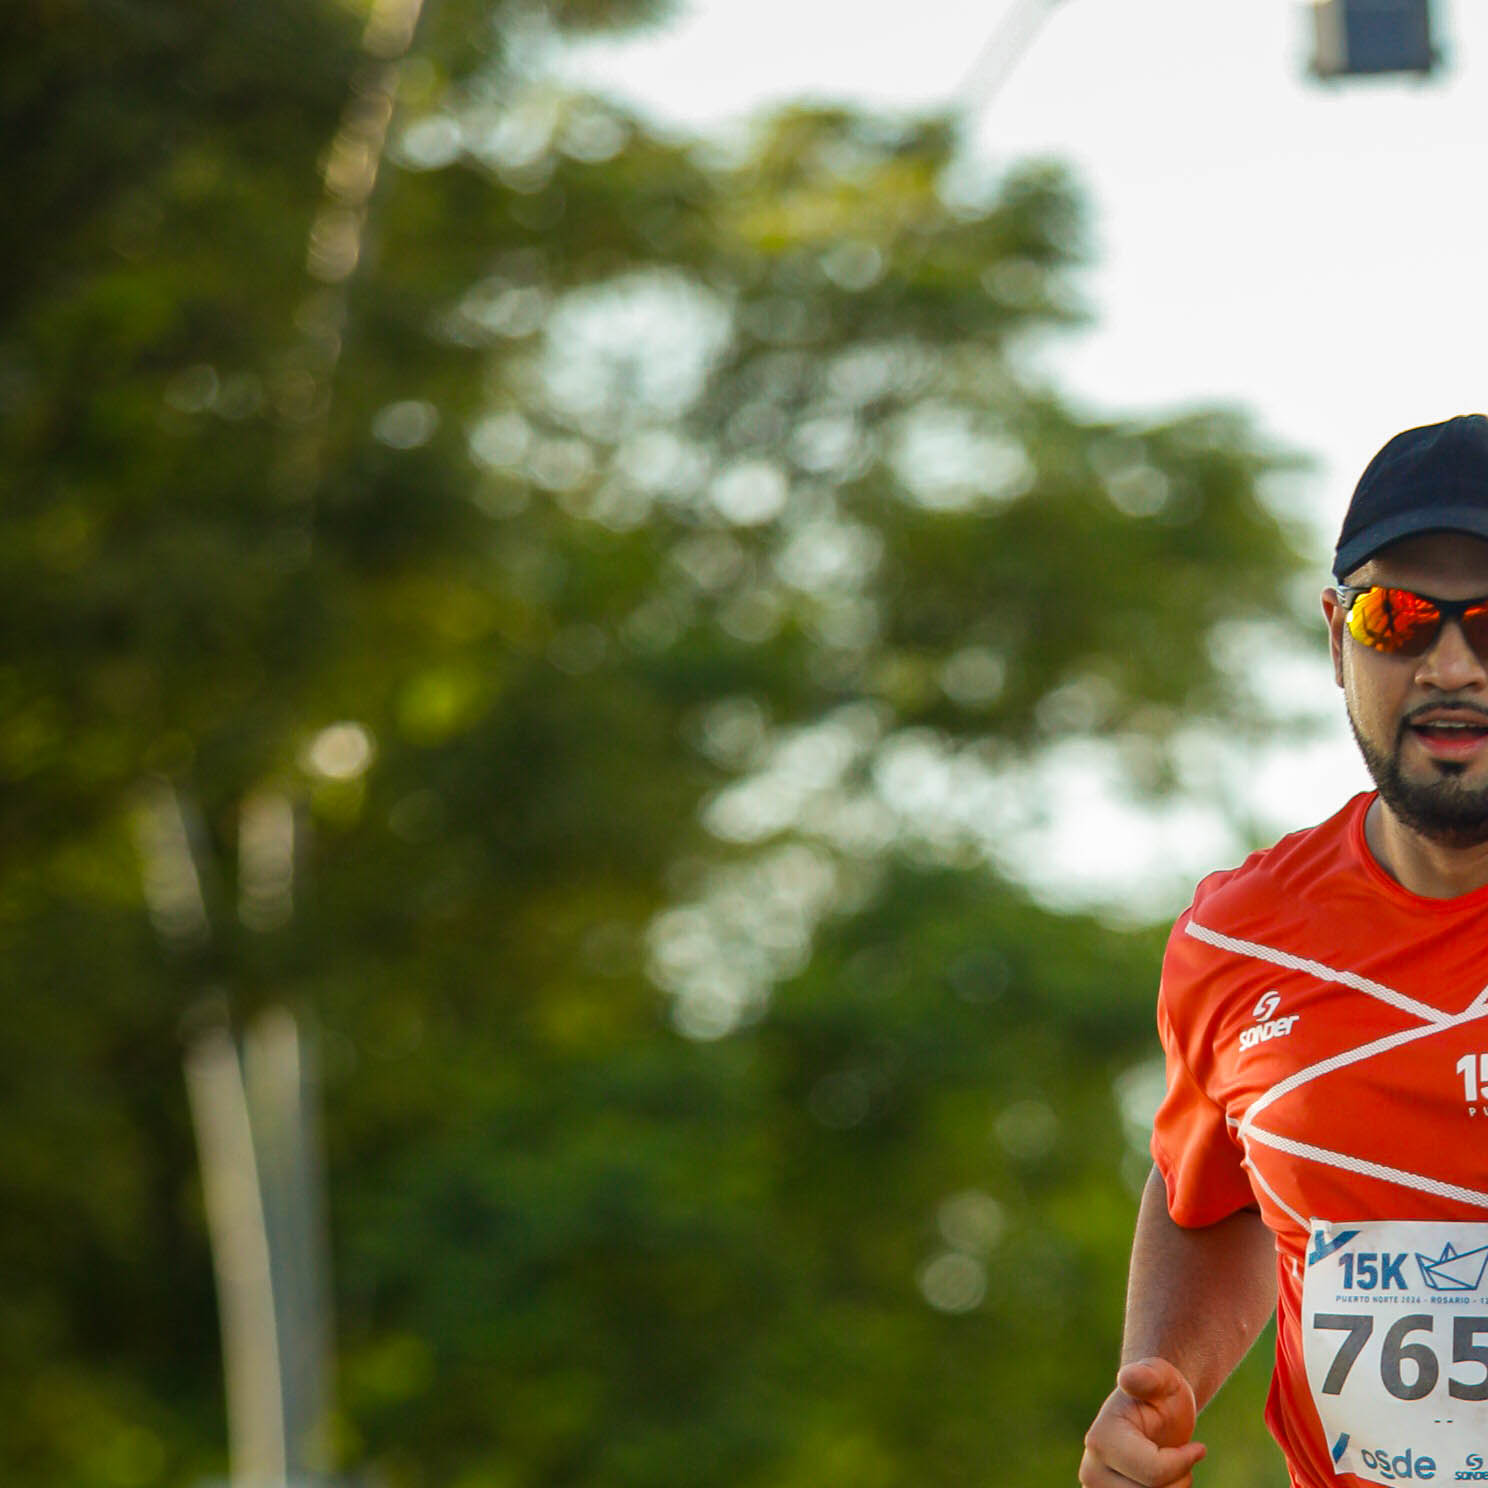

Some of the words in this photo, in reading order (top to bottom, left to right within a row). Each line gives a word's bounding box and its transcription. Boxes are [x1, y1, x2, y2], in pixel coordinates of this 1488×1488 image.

[1338, 1252, 1408, 1290] 15K
[1430, 1296, 1470, 1305] ROSARIO
[1361, 1448, 1436, 1480] osde
